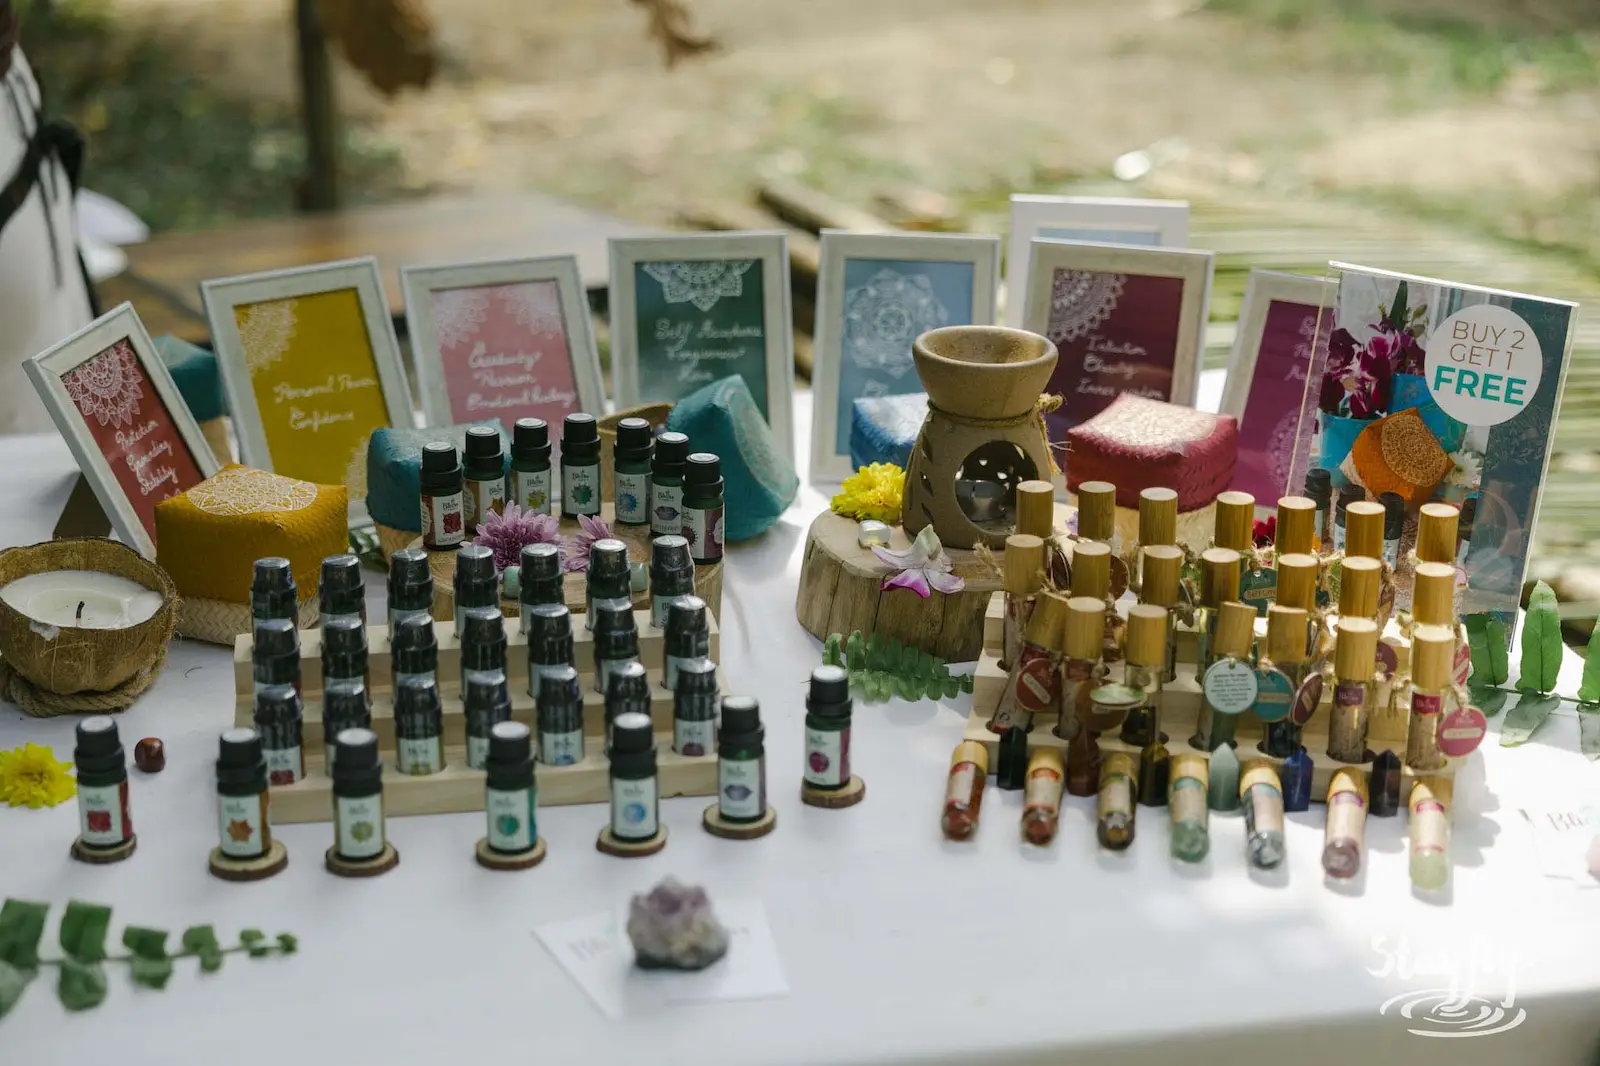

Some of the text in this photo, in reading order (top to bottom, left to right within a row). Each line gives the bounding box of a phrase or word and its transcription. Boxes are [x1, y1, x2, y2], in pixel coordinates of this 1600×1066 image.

[1452, 320, 1526, 350] BUY 2
[1450, 343, 1514, 371] GET 1
[1433, 364, 1528, 406] FREE
